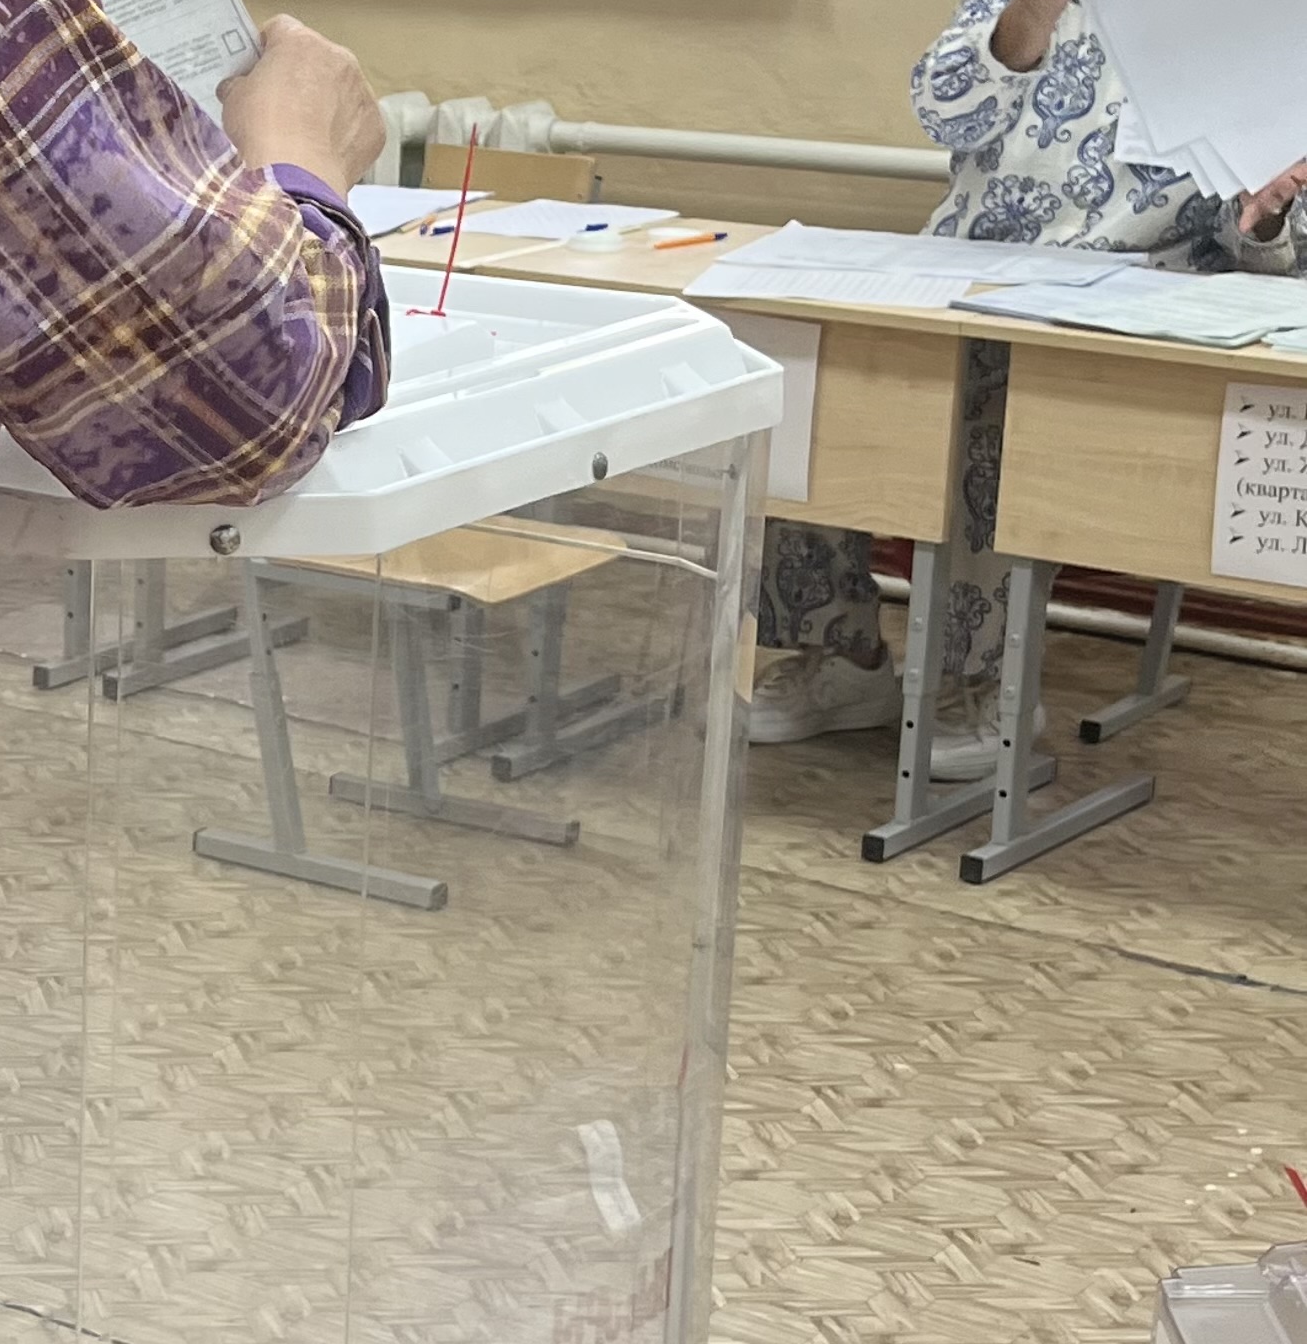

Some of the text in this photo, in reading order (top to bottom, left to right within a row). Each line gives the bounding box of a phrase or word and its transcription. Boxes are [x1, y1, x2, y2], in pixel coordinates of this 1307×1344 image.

[1266, 403, 1298, 422] ул.
[1264, 430, 1294, 449] ул.
[1261, 457, 1292, 476] ул.
[1257, 509, 1287, 528] ул.
[1255, 536, 1285, 555] ул.
